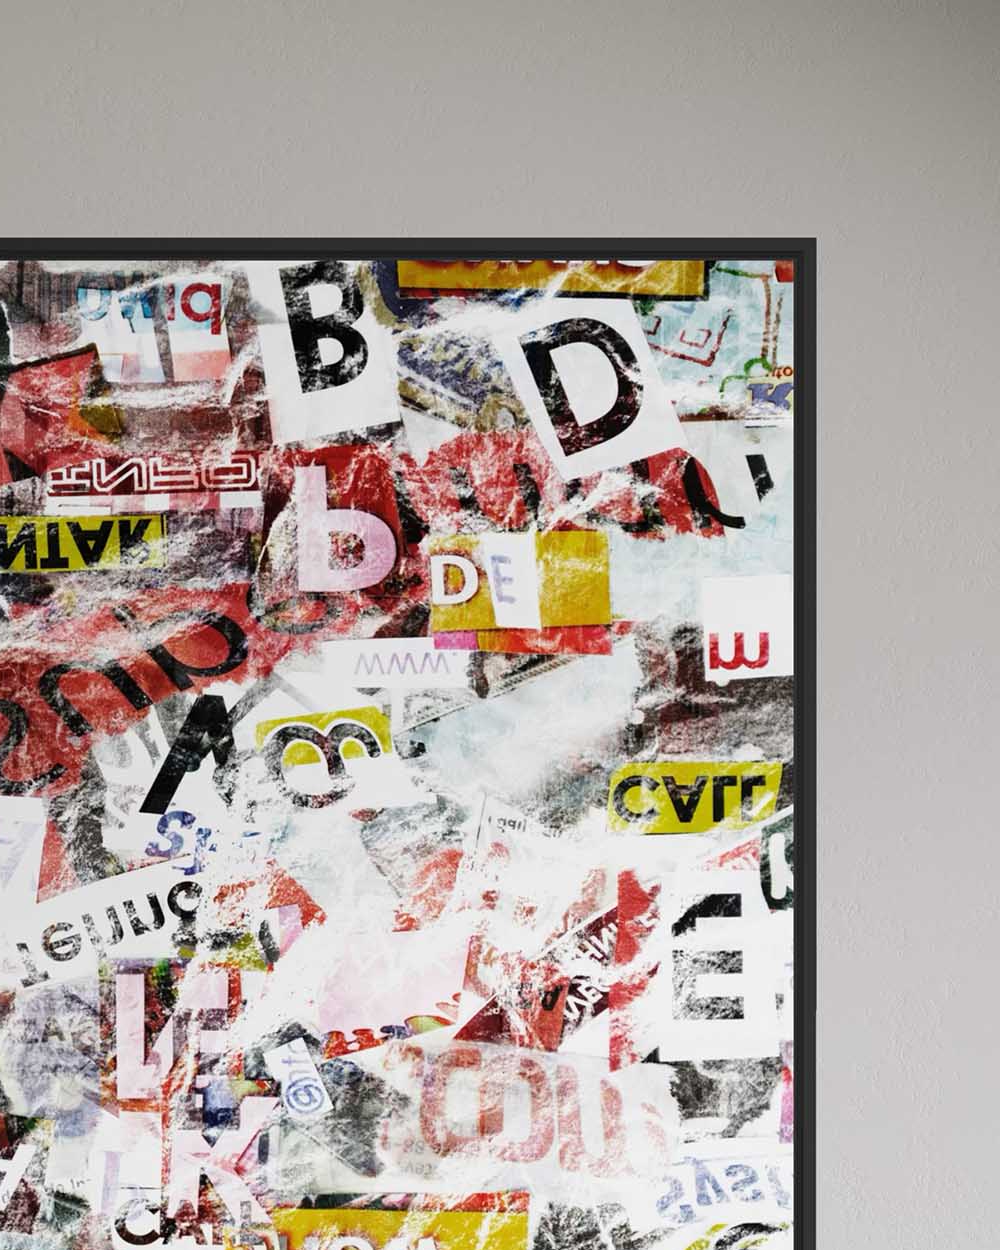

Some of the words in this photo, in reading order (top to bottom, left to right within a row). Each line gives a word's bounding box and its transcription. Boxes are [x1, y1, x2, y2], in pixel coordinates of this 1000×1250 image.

[278, 262, 370, 394] B
[518, 317, 643, 457] D
[671, 892, 746, 1021] E
